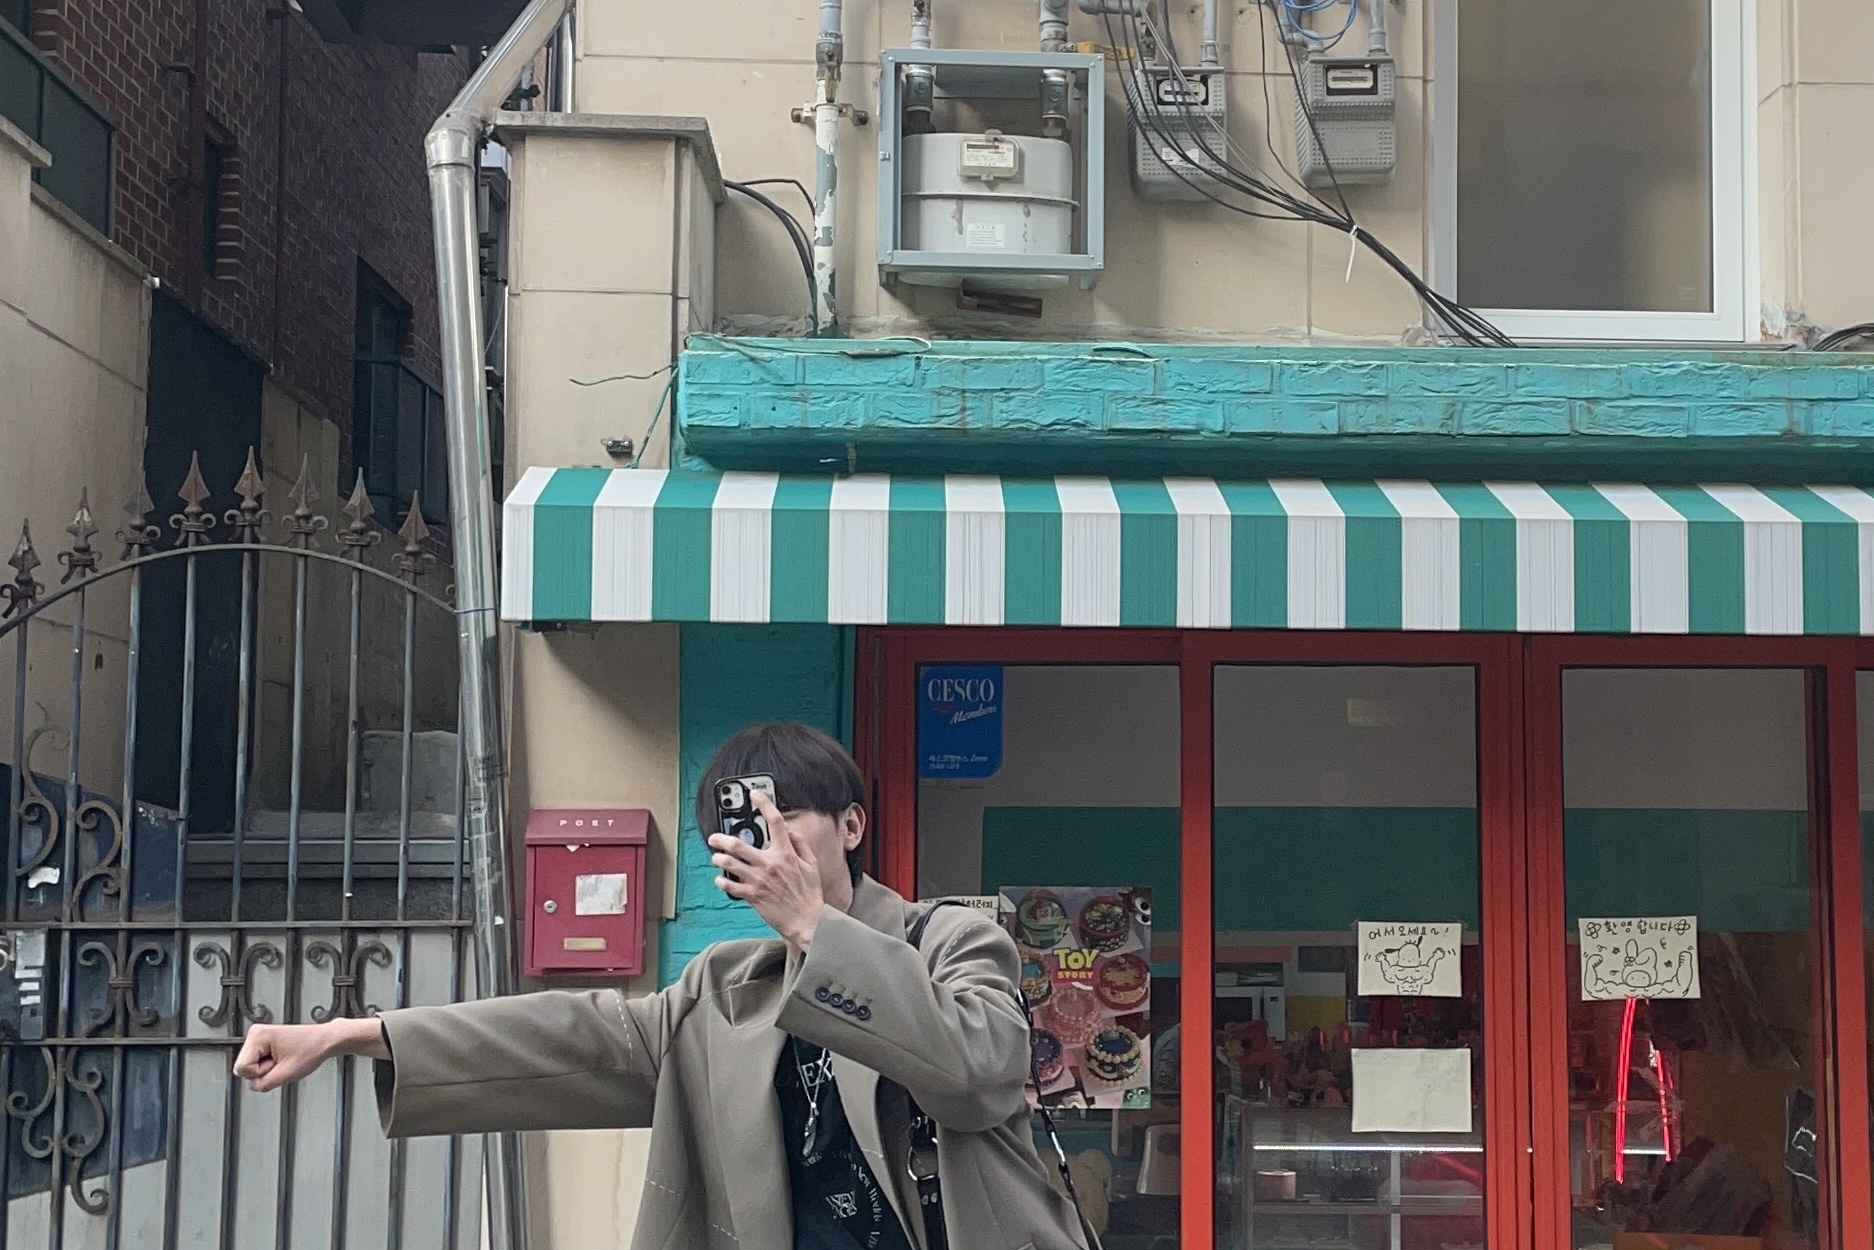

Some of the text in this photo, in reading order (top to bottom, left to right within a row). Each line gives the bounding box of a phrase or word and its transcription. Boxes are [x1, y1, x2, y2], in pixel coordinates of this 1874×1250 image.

[927, 677, 995, 703] CESCO
[559, 818, 615, 828] POST
[1604, 919, 1672, 936] 환영합니다
[1052, 947, 1100, 971] TOY
[1056, 970, 1095, 980] STORY
